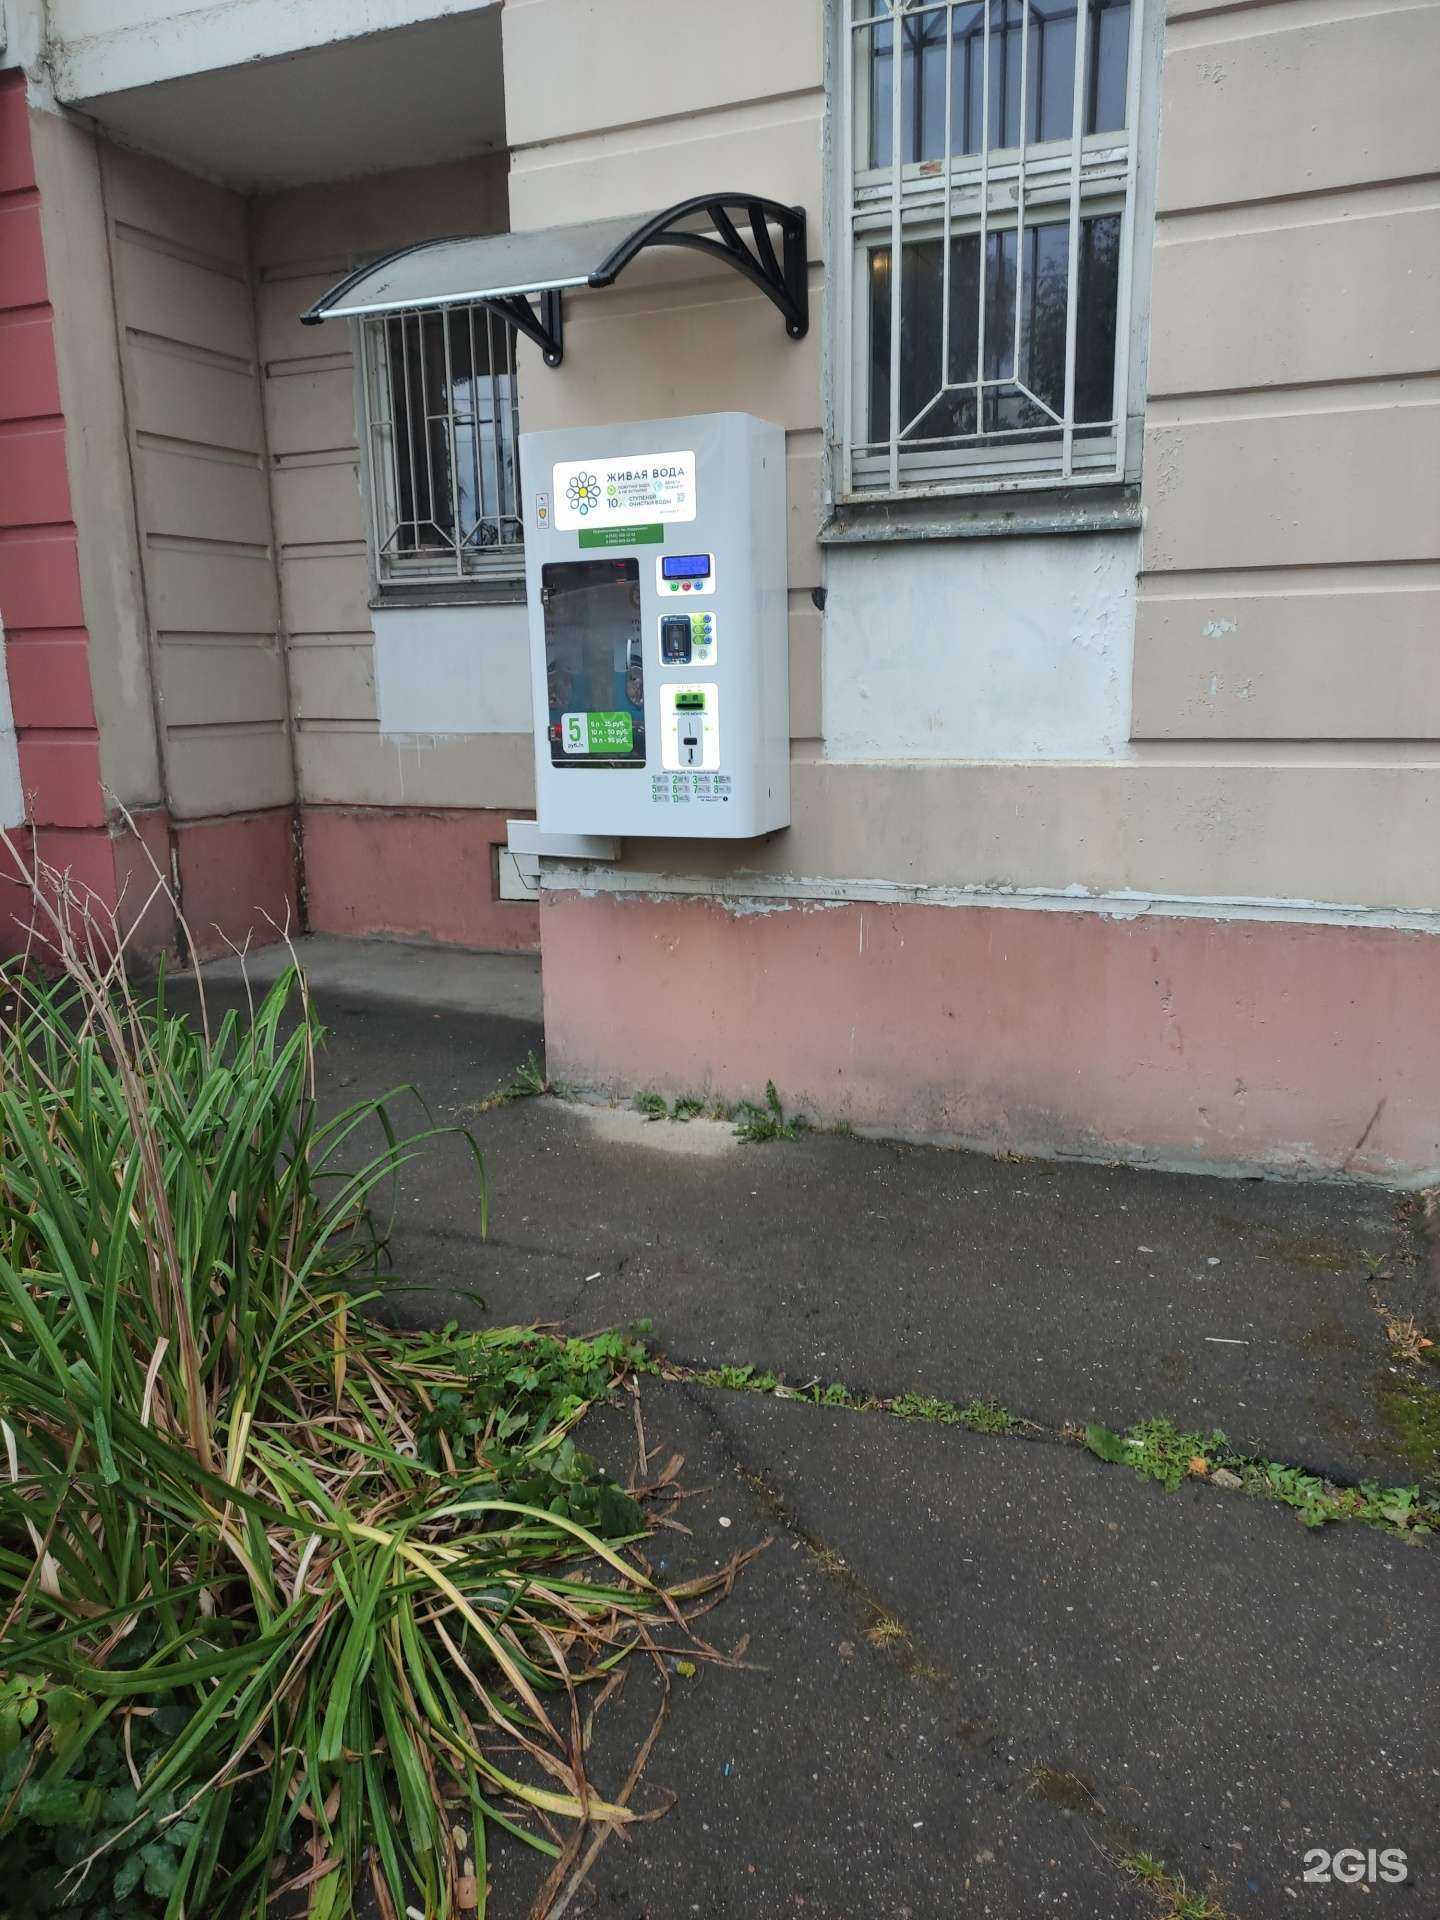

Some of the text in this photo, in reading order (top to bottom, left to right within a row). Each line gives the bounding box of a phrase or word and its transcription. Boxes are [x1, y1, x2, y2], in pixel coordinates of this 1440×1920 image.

[607, 467, 685, 482] ЖИВАЯ ВОДА
[607, 498, 618, 508] 10
[568, 717, 581, 742] 5
